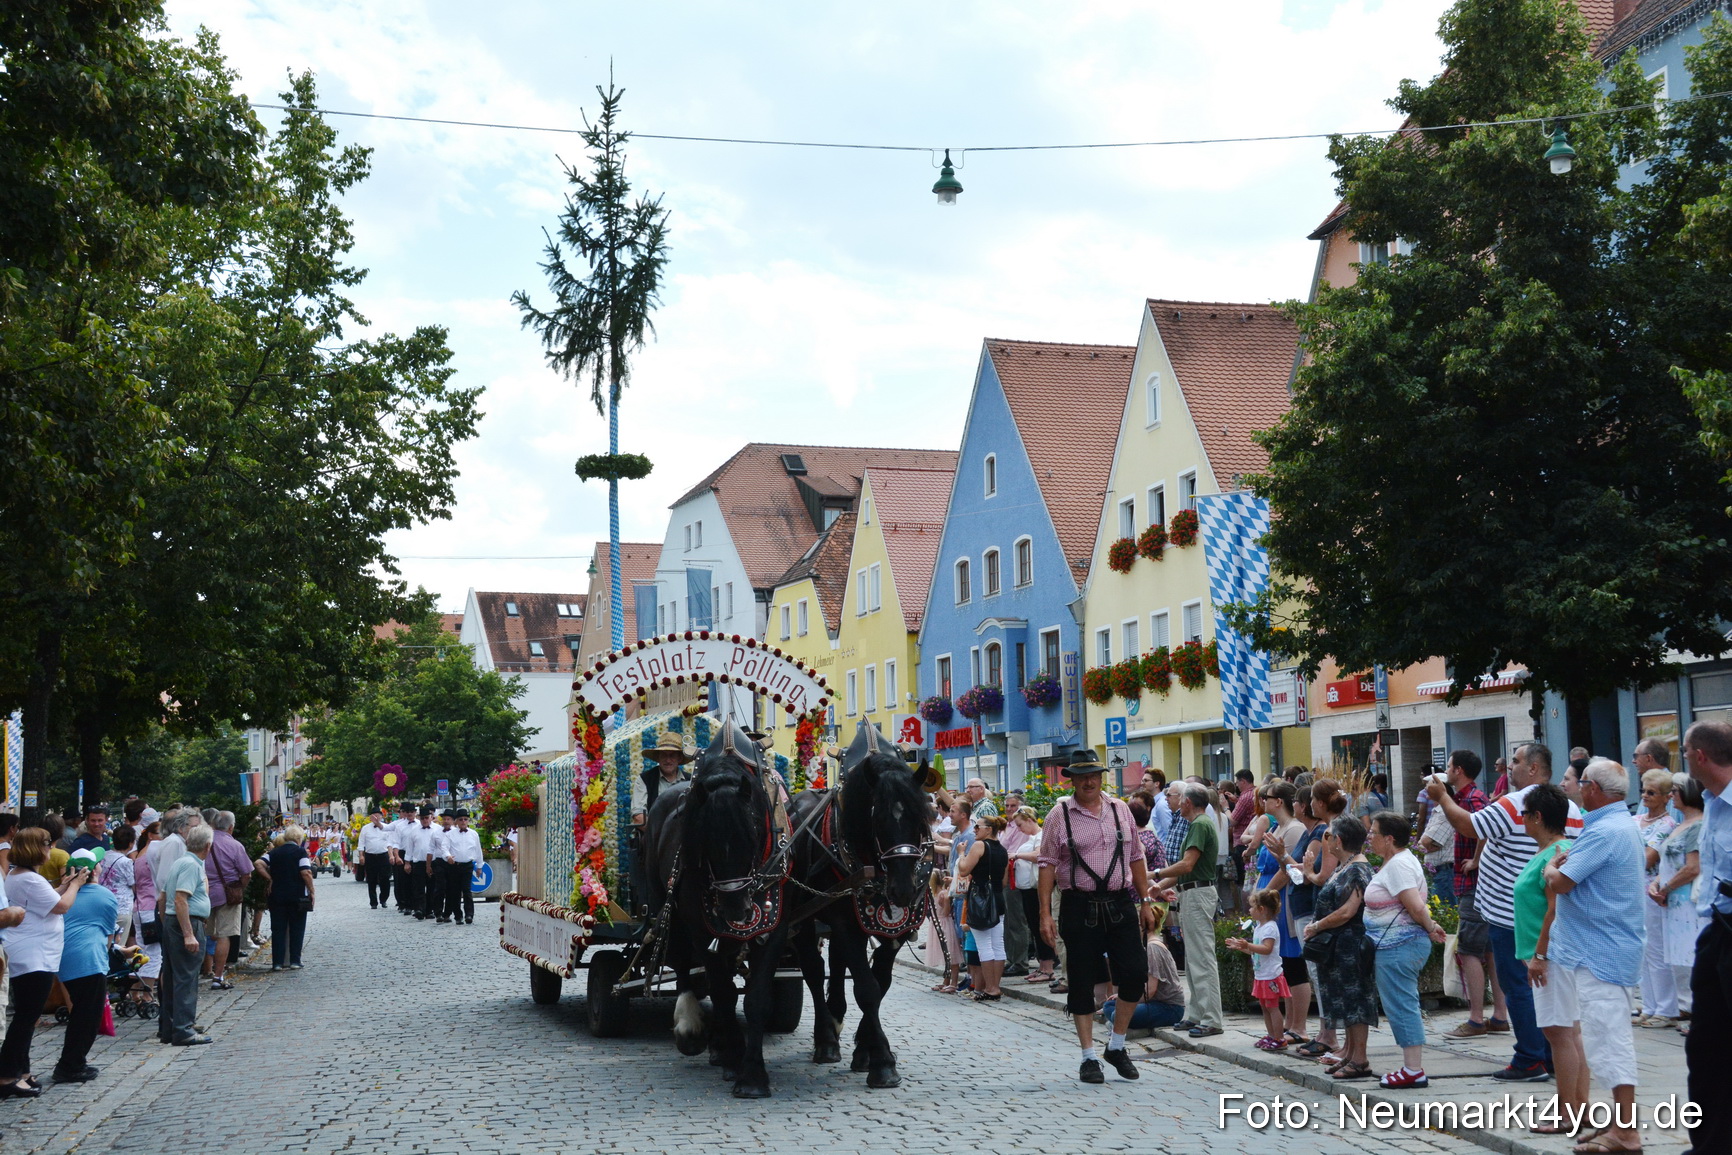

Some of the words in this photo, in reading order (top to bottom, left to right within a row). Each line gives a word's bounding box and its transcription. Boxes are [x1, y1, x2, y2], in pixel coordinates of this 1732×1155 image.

[595, 643, 706, 700] Festplatz
[728, 645, 806, 704] Pölling
[1360, 682, 1376, 692] DE
[1064, 666, 1078, 723] WITTL
[1275, 692, 1288, 704] KINO
[1296, 671, 1306, 722] KINO
[1110, 720, 1122, 744] P
